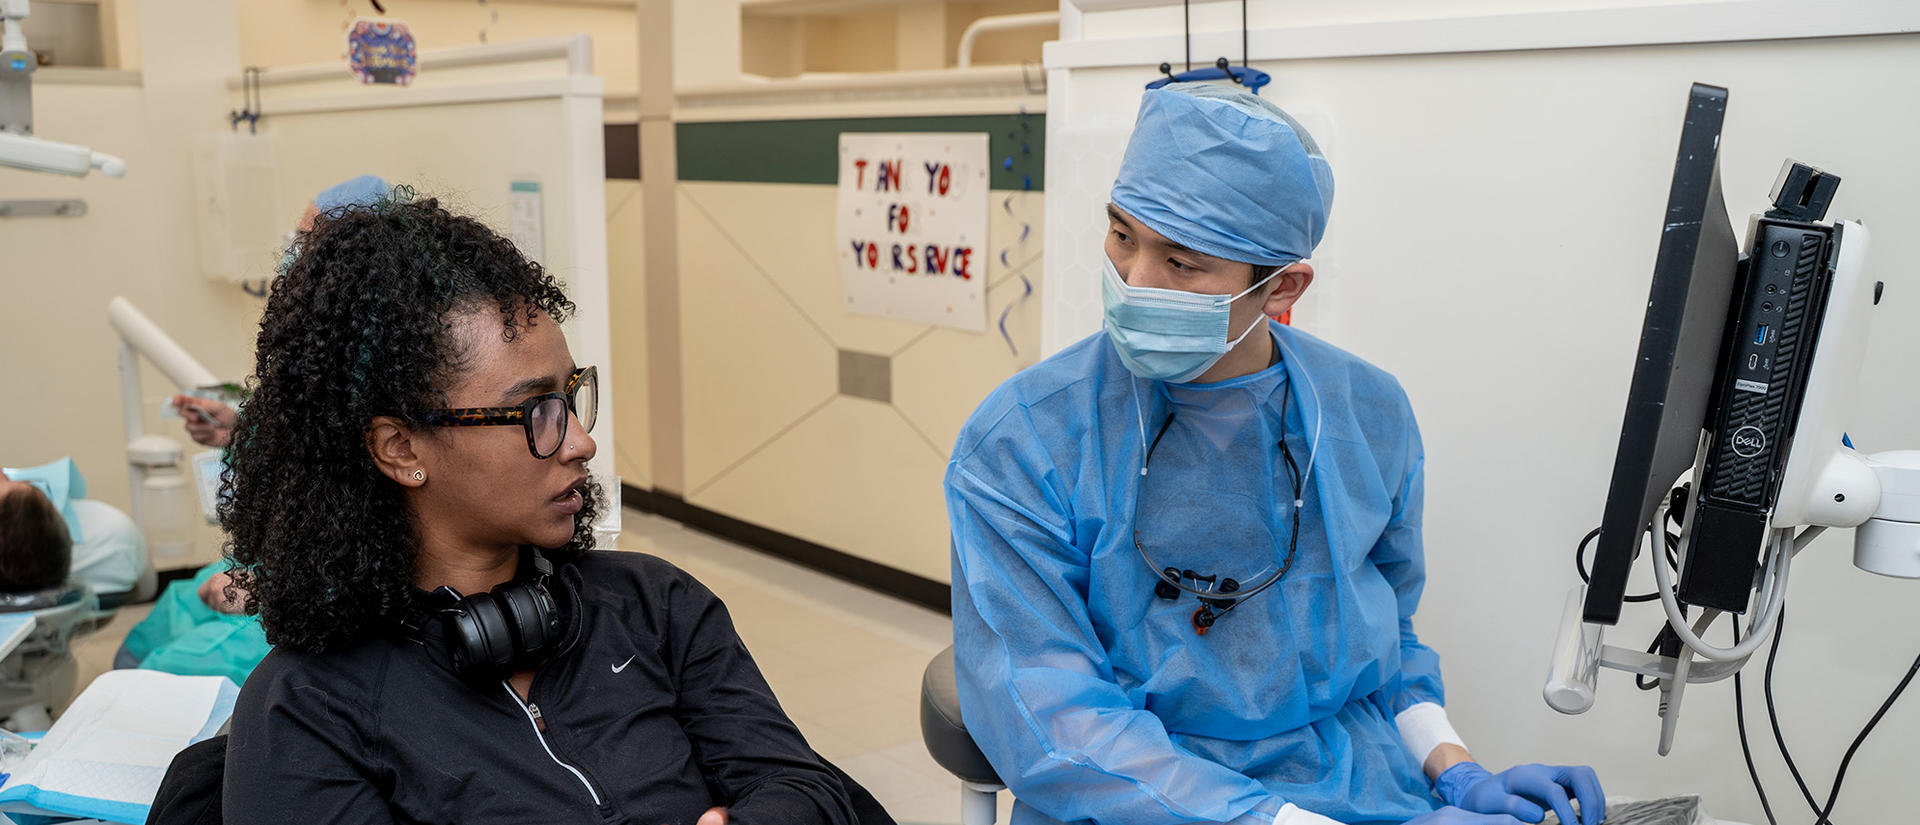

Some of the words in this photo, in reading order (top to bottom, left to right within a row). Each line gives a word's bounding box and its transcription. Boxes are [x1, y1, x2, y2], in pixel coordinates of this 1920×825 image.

[854, 159, 914, 193] TAN
[851, 239, 904, 271] YOR
[906, 244, 973, 280] SRVCE
[1736, 436, 1761, 448] DELL
